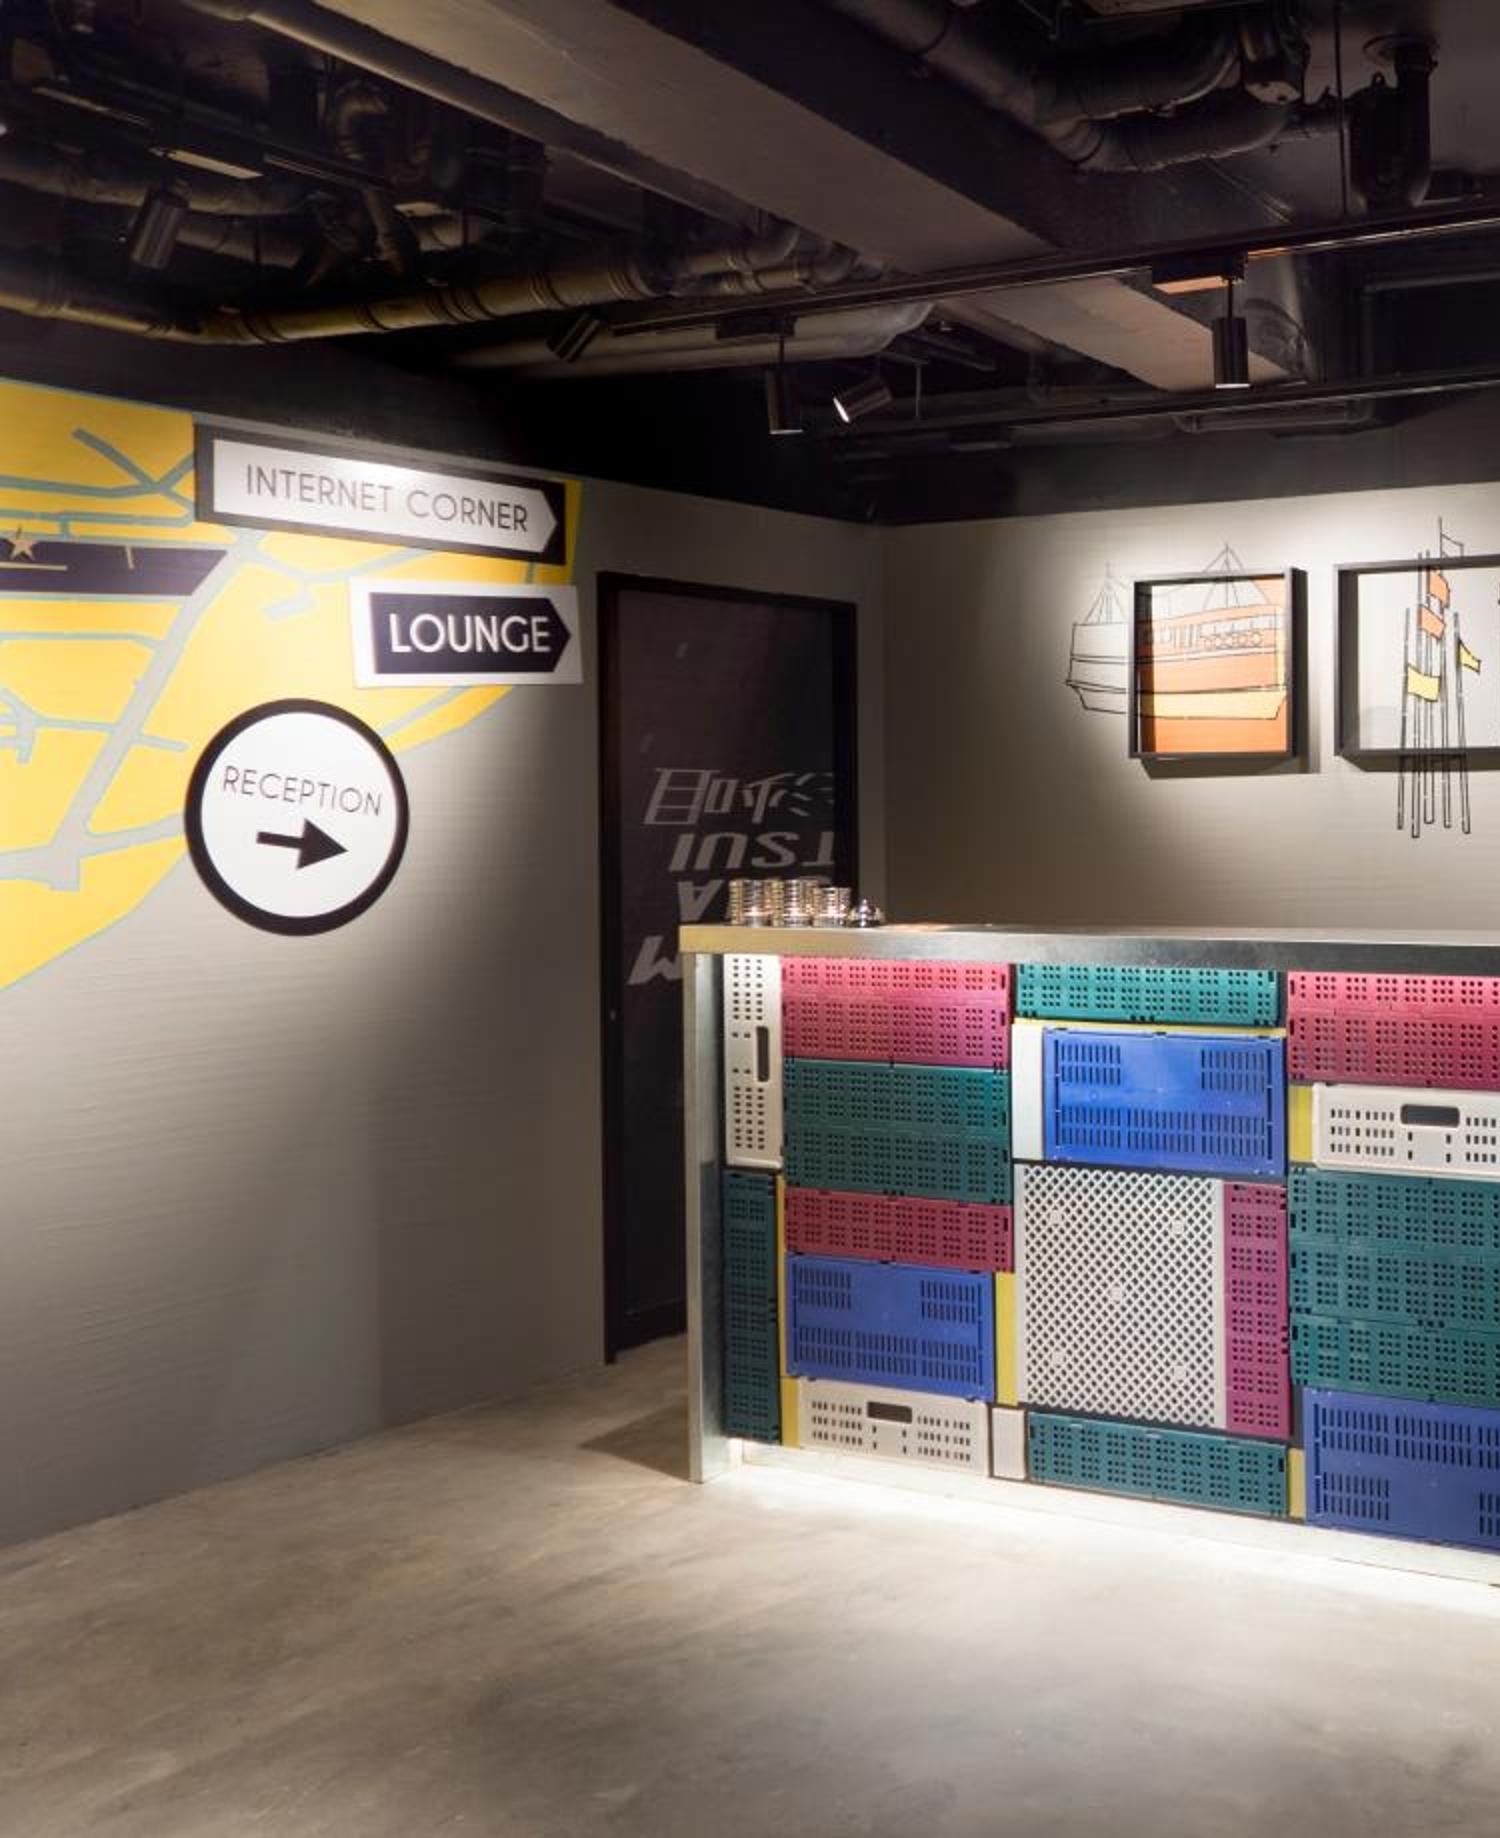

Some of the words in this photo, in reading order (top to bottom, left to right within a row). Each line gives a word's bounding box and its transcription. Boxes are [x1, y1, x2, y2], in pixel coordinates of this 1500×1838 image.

[246, 464, 393, 513] INTERNET
[405, 489, 529, 533] CORNER
[389, 613, 551, 653] LOUNGE
[223, 765, 383, 817] RECEPTION
